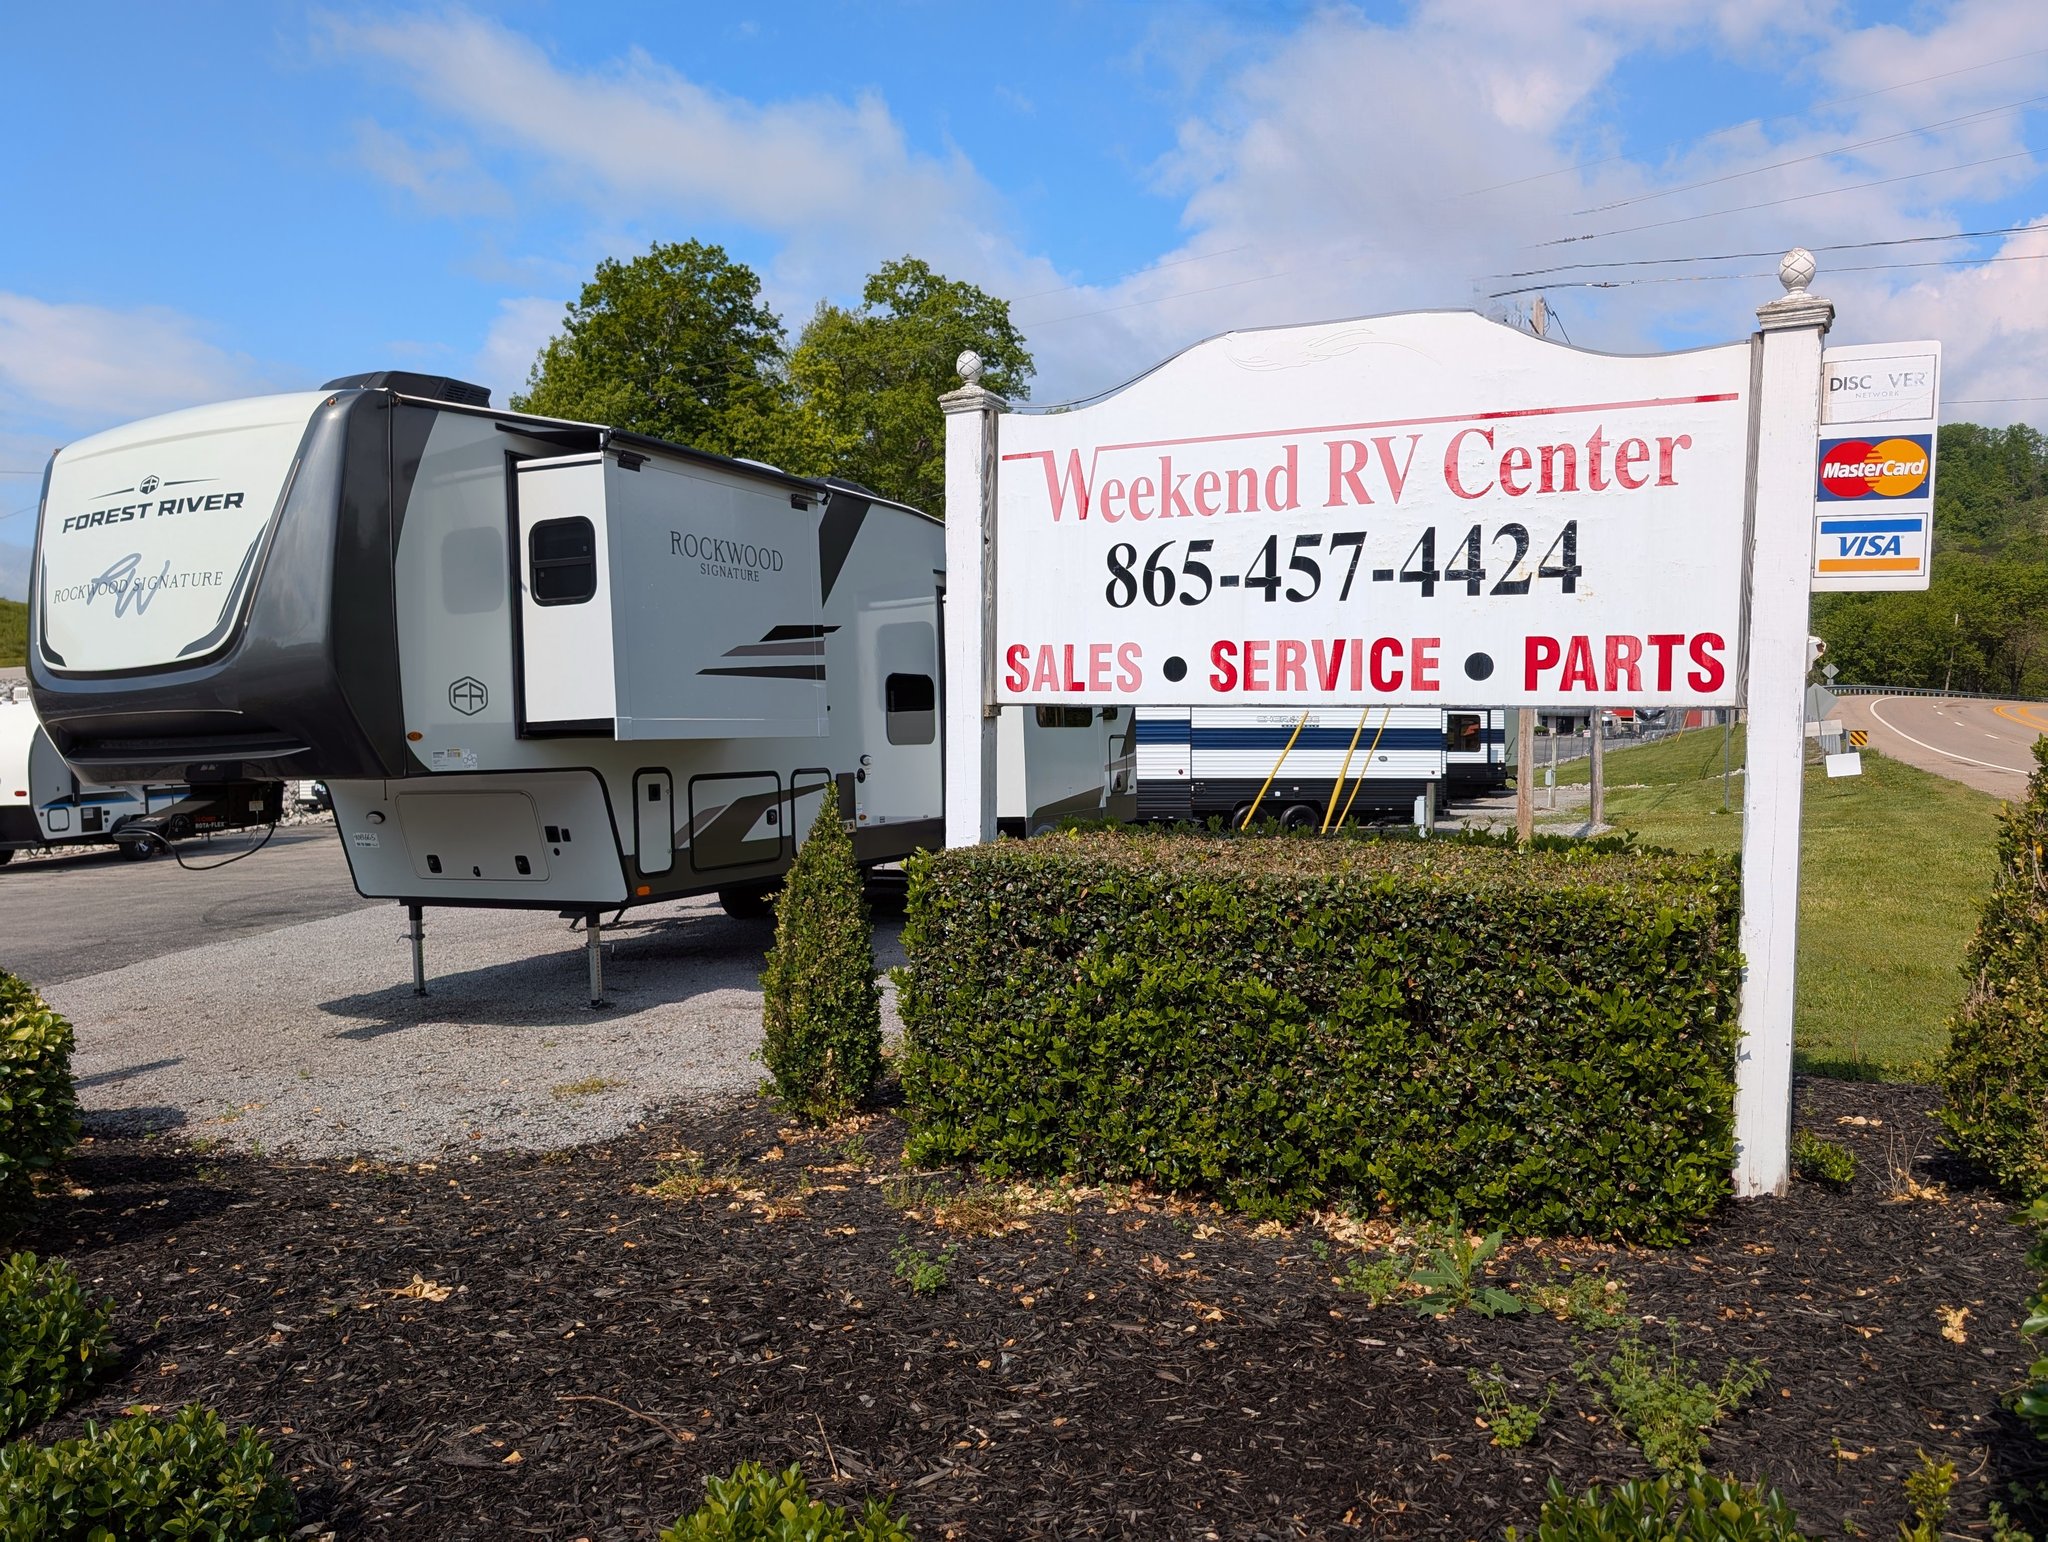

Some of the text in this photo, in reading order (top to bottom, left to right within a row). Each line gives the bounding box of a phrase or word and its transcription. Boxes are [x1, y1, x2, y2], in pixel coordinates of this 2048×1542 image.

[1829, 371, 1926, 392] DISCVER
[1855, 391, 1899, 399] NETWORK
[1042, 424, 1692, 524] Weekend RV Center
[1822, 459, 1925, 479] MasterCard
[62, 492, 244, 534] FOREST RIVER
[670, 530, 784, 572] ROCKWOOD
[1837, 535, 1901, 557] VISA
[700, 562, 760, 582] SIGNATURE
[1105, 519, 1583, 608] 865-457-4424
[53, 571, 223, 604] ROCKWOOD SIGNATURE
[1005, 632, 1725, 693] SALES SERVICE PARTS
